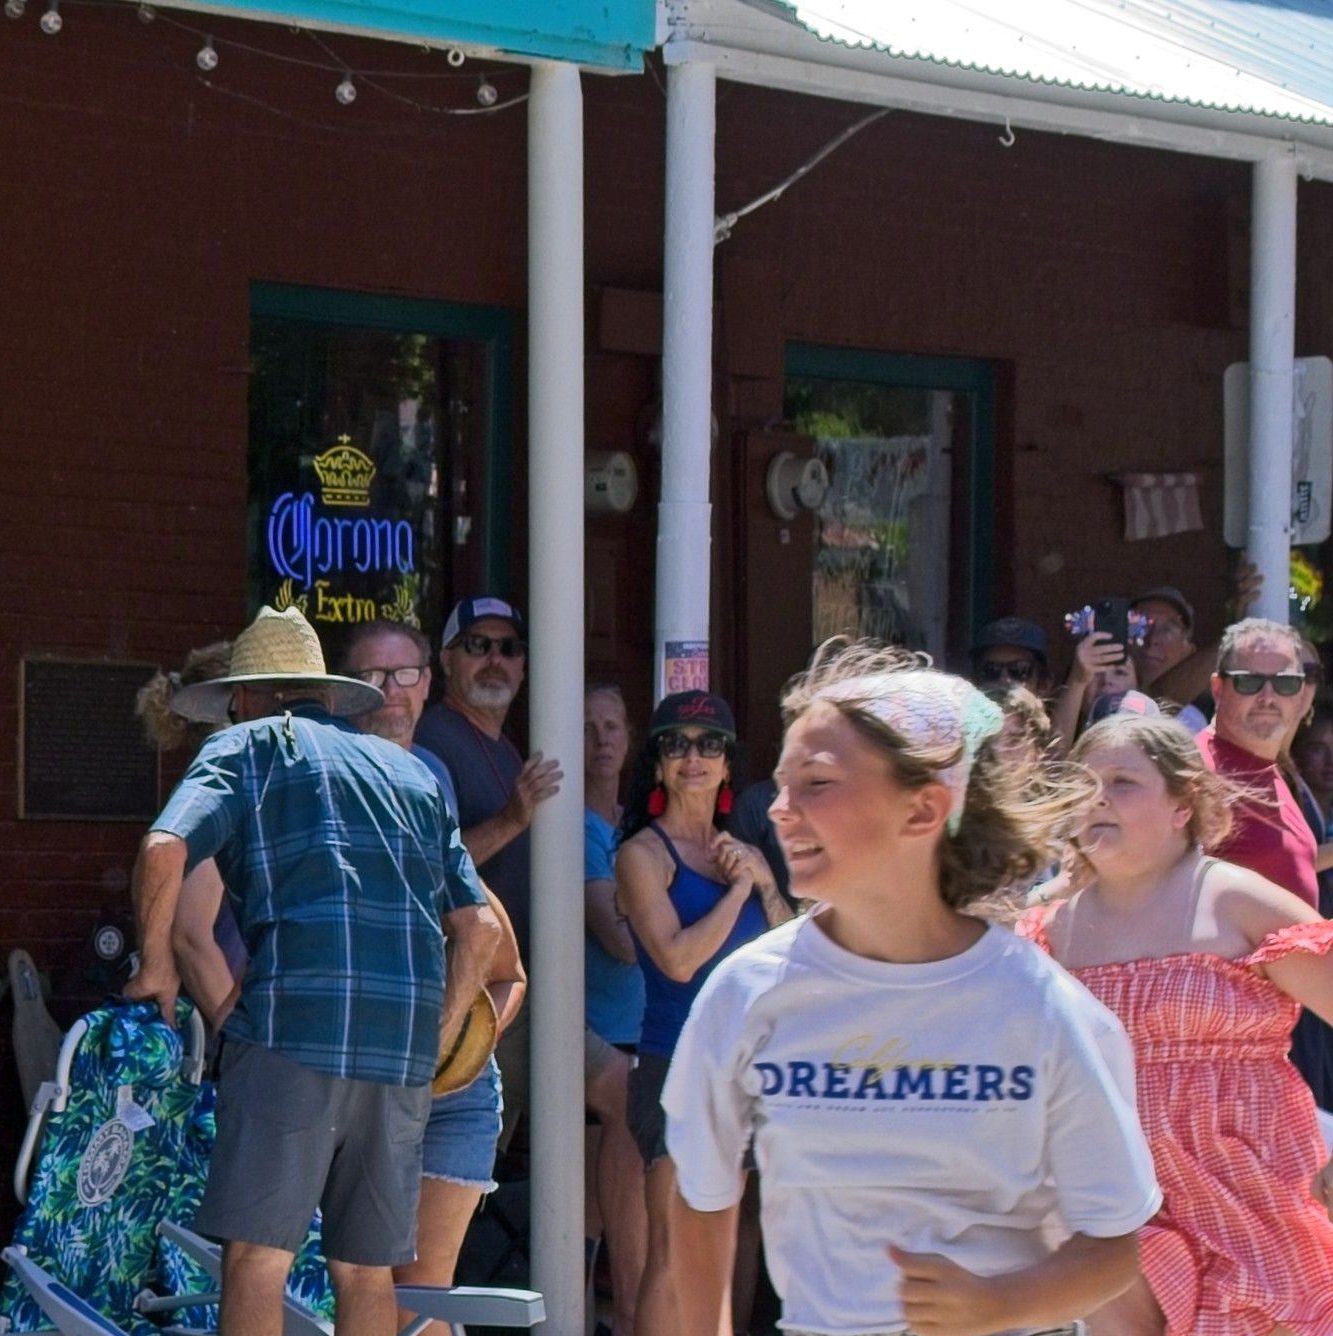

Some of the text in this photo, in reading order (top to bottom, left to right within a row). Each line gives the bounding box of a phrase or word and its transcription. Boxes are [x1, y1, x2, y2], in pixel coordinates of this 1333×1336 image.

[268, 491, 414, 590] Corona
[314, 579, 375, 622] Extra
[753, 1060, 1036, 1101] DREAMERS
